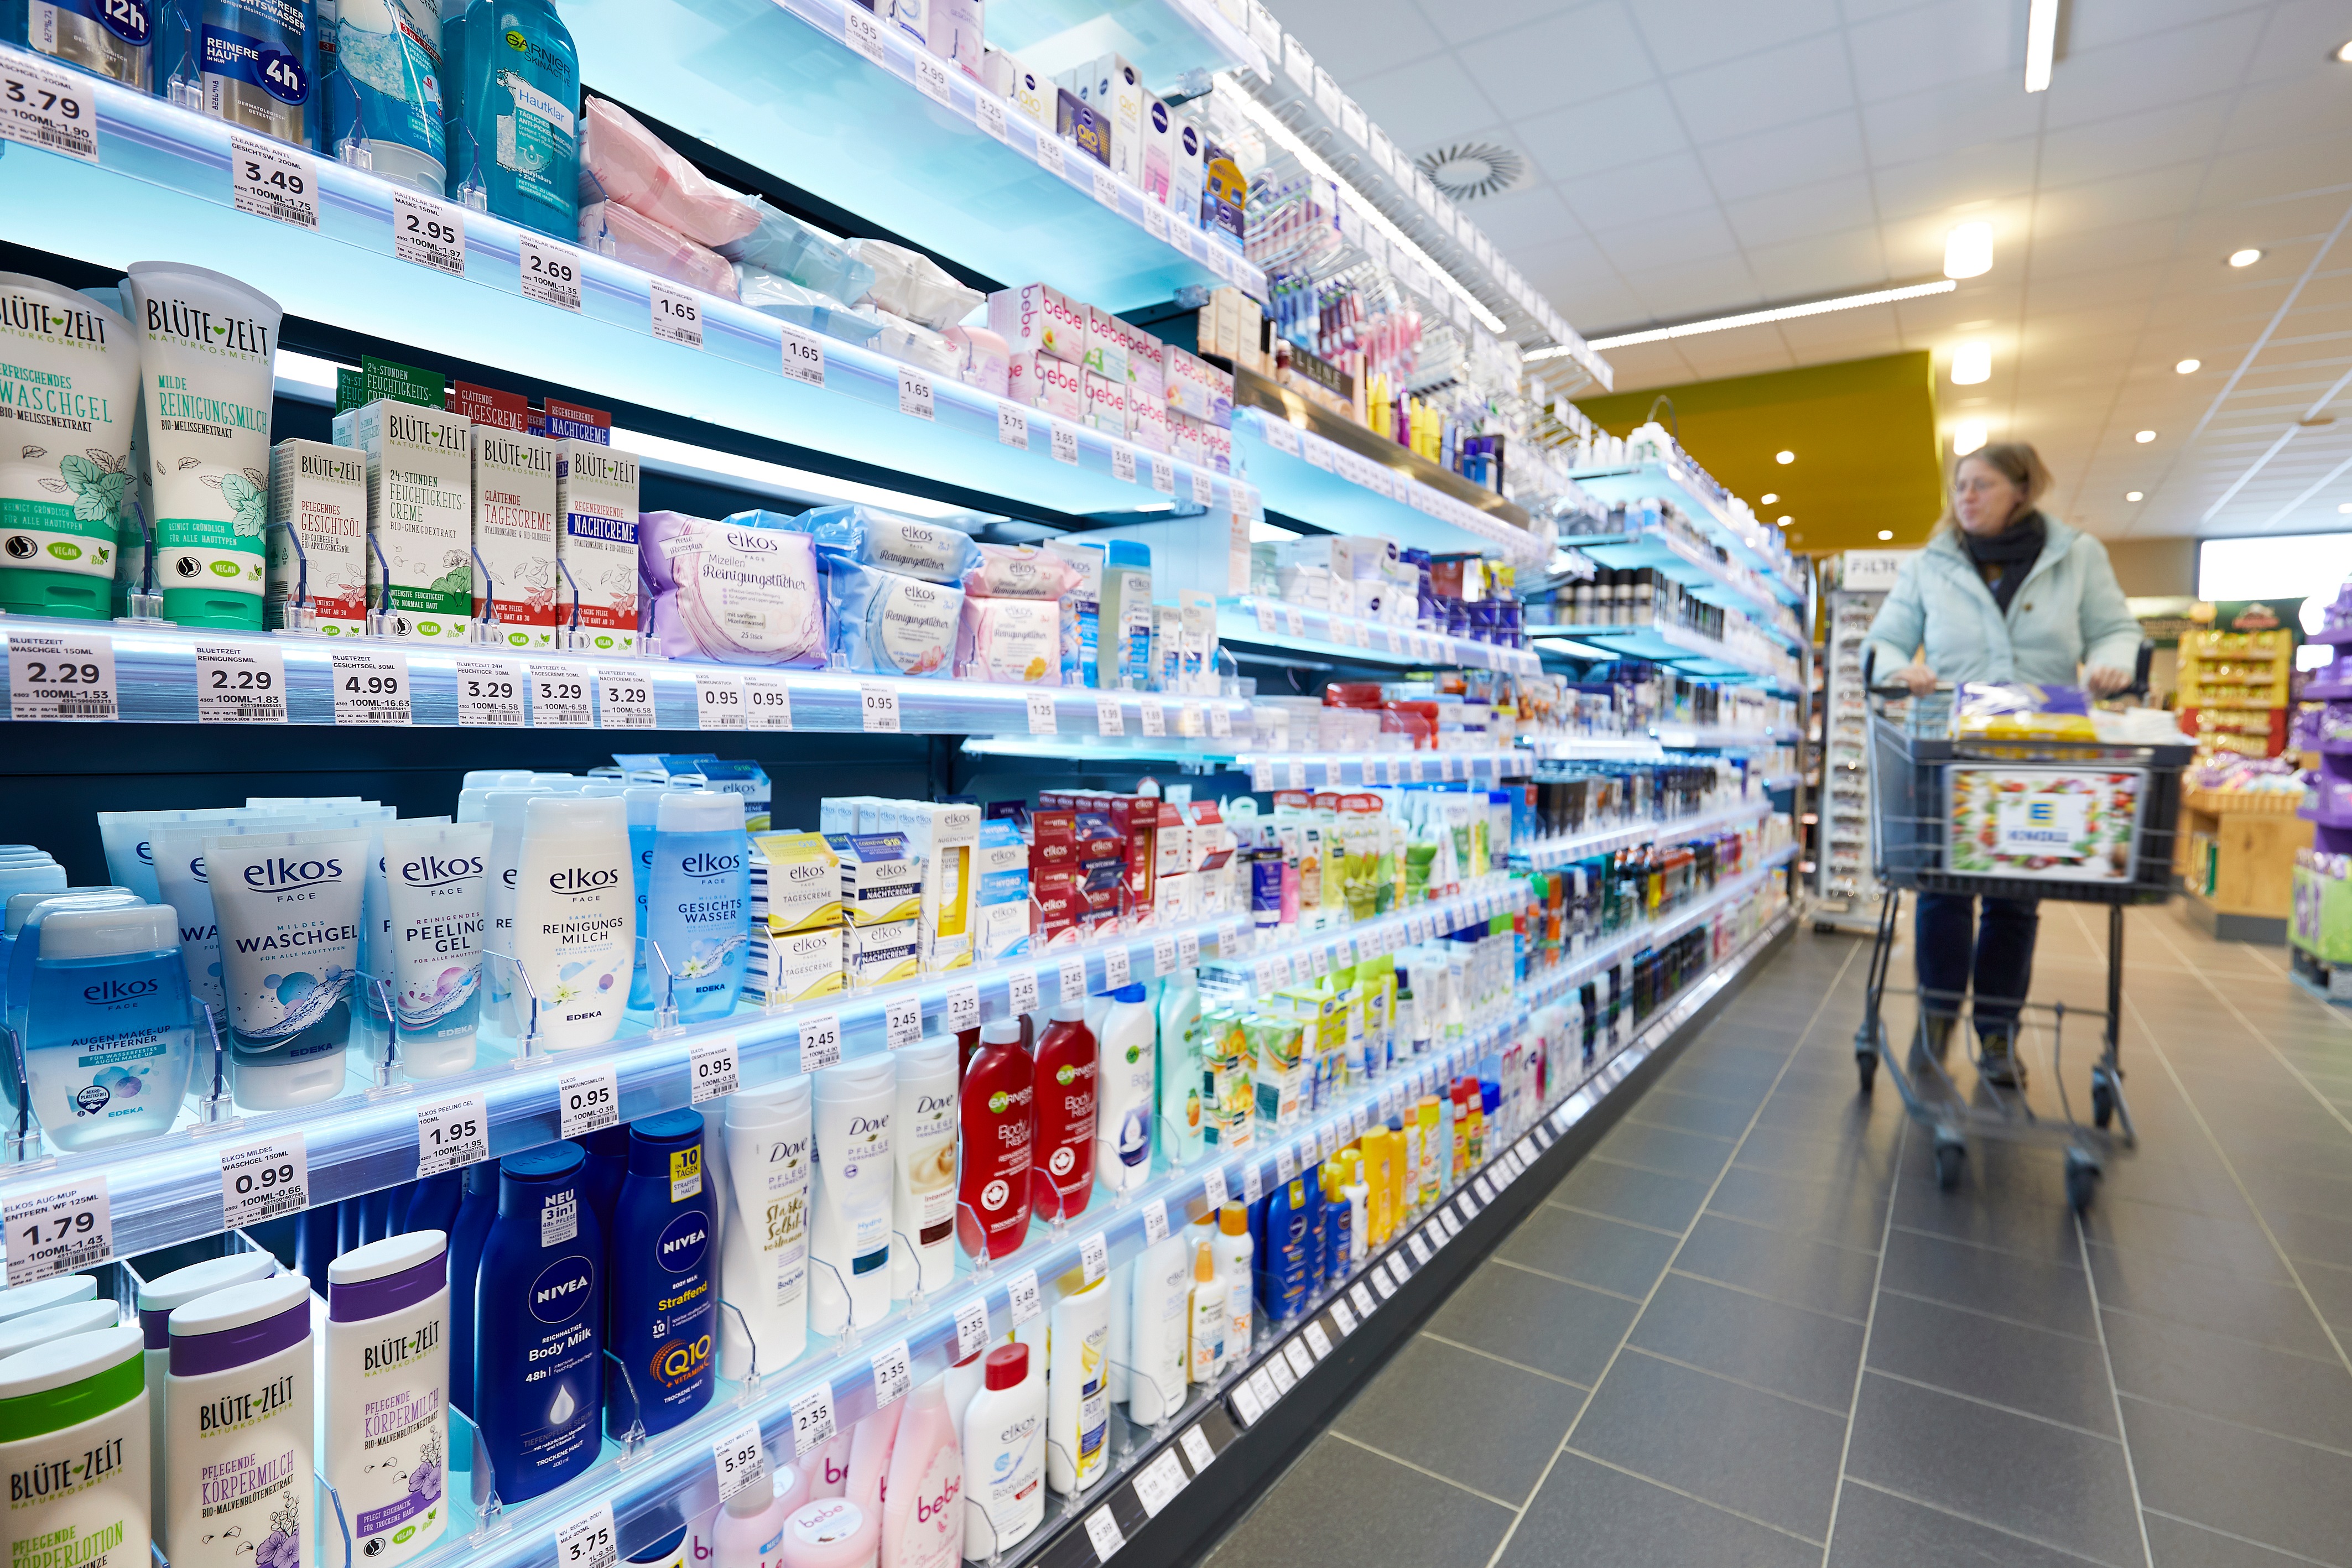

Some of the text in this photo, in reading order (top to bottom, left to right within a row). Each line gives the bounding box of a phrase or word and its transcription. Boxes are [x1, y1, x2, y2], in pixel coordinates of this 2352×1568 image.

[850, 13, 877, 40] 6.95
[207, 37, 259, 60] REINERE
[207, 48, 239, 62] HAUT
[506, 32, 571, 77] GARNIER
[266, 59, 298, 91] 4h
[524, 50, 570, 88] SKINACTIVE
[920, 61, 945, 84] 2.99
[6, 79, 80, 119] 3.79
[519, 88, 564, 122] Hautklar
[13, 109, 90, 138] 100ML-1.90
[231, 136, 270, 154] CLEARASIL
[231, 143, 302, 170] GESICHTSW. 200ML
[244, 161, 304, 195] 3.49
[250, 186, 311, 211] 100ML-1.75
[395, 197, 439, 216] MASKE 150ML
[405, 214, 455, 244] 2.95
[410, 237, 461, 258] 100ML-1.97
[530, 254, 573, 282] 2.69
[652, 284, 693, 302] MIZELLENTUECHER
[660, 299, 695, 321] 1.65
[1021, 284, 1039, 338] bebe
[1042, 286, 1083, 330] bebe
[147, 299, 268, 356] BLÜTE ZEIT
[149, 334, 269, 367] NATURKOSMETIK
[790, 342, 818, 361] 1.65
[367, 362, 408, 381] 24-STUNDEN
[158, 375, 186, 390] MILDE
[367, 374, 432, 401] FEUCHTIGKEITS-
[905, 381, 929, 397] 1.65
[0, 384, 112, 423] WASCHGEL
[159, 392, 267, 435] REINIGUNGSMILCH
[551, 406, 594, 424] REGENERIERENDE
[1003, 414, 1023, 429] 3.75
[161, 420, 232, 438] BIO-MELISSENEXTRAKT
[389, 415, 466, 452] BLÜTE ZEIT
[551, 419, 606, 444] NACHTCREME
[389, 439, 467, 459] NATURKOSMETIK
[390, 469, 438, 487] 24-STUNDEN
[390, 483, 466, 510] FEUCHTIGKEITS-
[485, 490, 521, 506] GLÄTTENDE
[301, 501, 340, 515] PFLEGENDES
[391, 502, 423, 523] CREME
[485, 503, 551, 532] TAGESCREME
[574, 501, 623, 518] REGENERIERENDE
[301, 513, 361, 538] GESICHTSÖL
[391, 521, 456, 539] BIO-GINKGOEXTRAKT
[574, 515, 635, 543] NACHTCREME
[902, 525, 933, 542] elkos
[669, 541, 704, 554] Rezeptur
[727, 531, 778, 552] elkos
[215, 564, 236, 574] VEGAN
[708, 554, 746, 567] Mizellen
[880, 549, 945, 571] Reinigungstücher
[703, 564, 808, 592] Reinigungstücher
[727, 618, 764, 627] Mizellenwasser
[9, 637, 63, 645] BLUETEZEIT
[750, 632, 763, 640] Stück
[197, 655, 257, 663] REINIGUNGSMIL.
[27, 663, 100, 684] 2.29
[211, 670, 272, 689] 2.29
[33, 690, 108, 699] 100ML-1.53
[345, 676, 398, 695] 4.99
[468, 681, 513, 698] 3.29
[540, 684, 582, 700] 3.29
[216, 695, 279, 704] 100ML-1.83
[350, 699, 410, 707] 100ML-16.63
[471, 702, 518, 711] 100ML-6.58
[705, 691, 738, 705] 0.95
[867, 697, 893, 710] 0.95
[1032, 705, 1051, 716] 1.25
[938, 835, 975, 843] AUGENCREME
[244, 858, 342, 885] elkos
[402, 856, 483, 881] elkos
[681, 853, 740, 873] elkos
[789, 864, 825, 881] elkos
[549, 868, 618, 889] elkos
[277, 893, 316, 903] FACE
[783, 890, 831, 903] TAGESCREME
[867, 887, 913, 899] NACHTCREME
[678, 899, 742, 914] GESICHTS
[277, 920, 325, 931] MILDES
[416, 912, 480, 925] REINIGENDES
[543, 917, 622, 935] REINIGUNGS
[684, 910, 736, 924] WASSER
[236, 925, 358, 953] WASCHGEL
[406, 919, 485, 942] PEELING
[561, 931, 609, 945] MILCH
[301, 946, 345, 956] HAUTTYPEN
[435, 936, 471, 954] GEL
[84, 978, 158, 1001] elkos
[1014, 984, 1033, 997] 2.45
[952, 999, 974, 1012] 2.25
[566, 1010, 602, 1022] EDEKA
[892, 1013, 916, 1028] 2.45
[71, 1025, 171, 1046] AUGEN MAKE-UP
[89, 1035, 158, 1052] ENTFERNER
[807, 1032, 835, 1048] 2.45
[699, 1058, 732, 1077] 0.95
[561, 1076, 605, 1091] REINIGUNGSMILCH
[81, 1092, 106, 1100] PLASTIKFREI
[570, 1087, 610, 1109] 0.95
[917, 1093, 954, 1114] Dove
[988, 1085, 1033, 1109] GARNIER
[108, 1106, 143, 1118] EDEKA
[418, 1109, 436, 1118] ELKOS
[438, 1102, 461, 1113] PEELING
[429, 1120, 477, 1145] 1.95
[849, 1114, 889, 1137] Dove
[221, 1146, 273, 1163] ELKOS MILDES
[433, 1139, 482, 1158] 100ML-1.95
[680, 1149, 697, 1166] 10
[769, 1137, 808, 1163] Dove
[223, 1150, 288, 1171] WASCHGEL 150ML
[235, 1164, 294, 1194] 0.99
[675, 1164, 698, 1178] TAGEN
[4, 1200, 33, 1212] ELKOS
[240, 1185, 301, 1207] 100ML-0.66
[545, 1189, 574, 1207] NEU
[6, 1194, 98, 1222] ENTFERN. WF 125ML
[22, 1212, 94, 1246] 1.79
[28, 1236, 103, 1262] 100ML-1.43
[664, 1230, 705, 1254] NIVEA
[538, 1275, 589, 1303] NIVEA
[658, 1281, 707, 1312] Straffend
[542, 1323, 582, 1343] REICHHALTIGE
[528, 1328, 591, 1362] Body Milk
[665, 1334, 711, 1376] Q10
[525, 1369, 547, 1383] 48h
[879, 1361, 905, 1385] 2.35
[200, 1376, 294, 1430] BLÜTE ZEIT
[799, 1405, 827, 1431] 2.35
[1001, 1414, 1037, 1441] elkos
[202, 1453, 257, 1480] PFLEGENDE
[725, 1445, 756, 1473] 5.95
[202, 1449, 294, 1506] KÖRPERMILCH
[202, 1474, 294, 1518] BIO-MALVENBLÜTENEXTRAKT
[917, 1476, 960, 1524] bebe
[569, 1528, 608, 1561] 3.75
